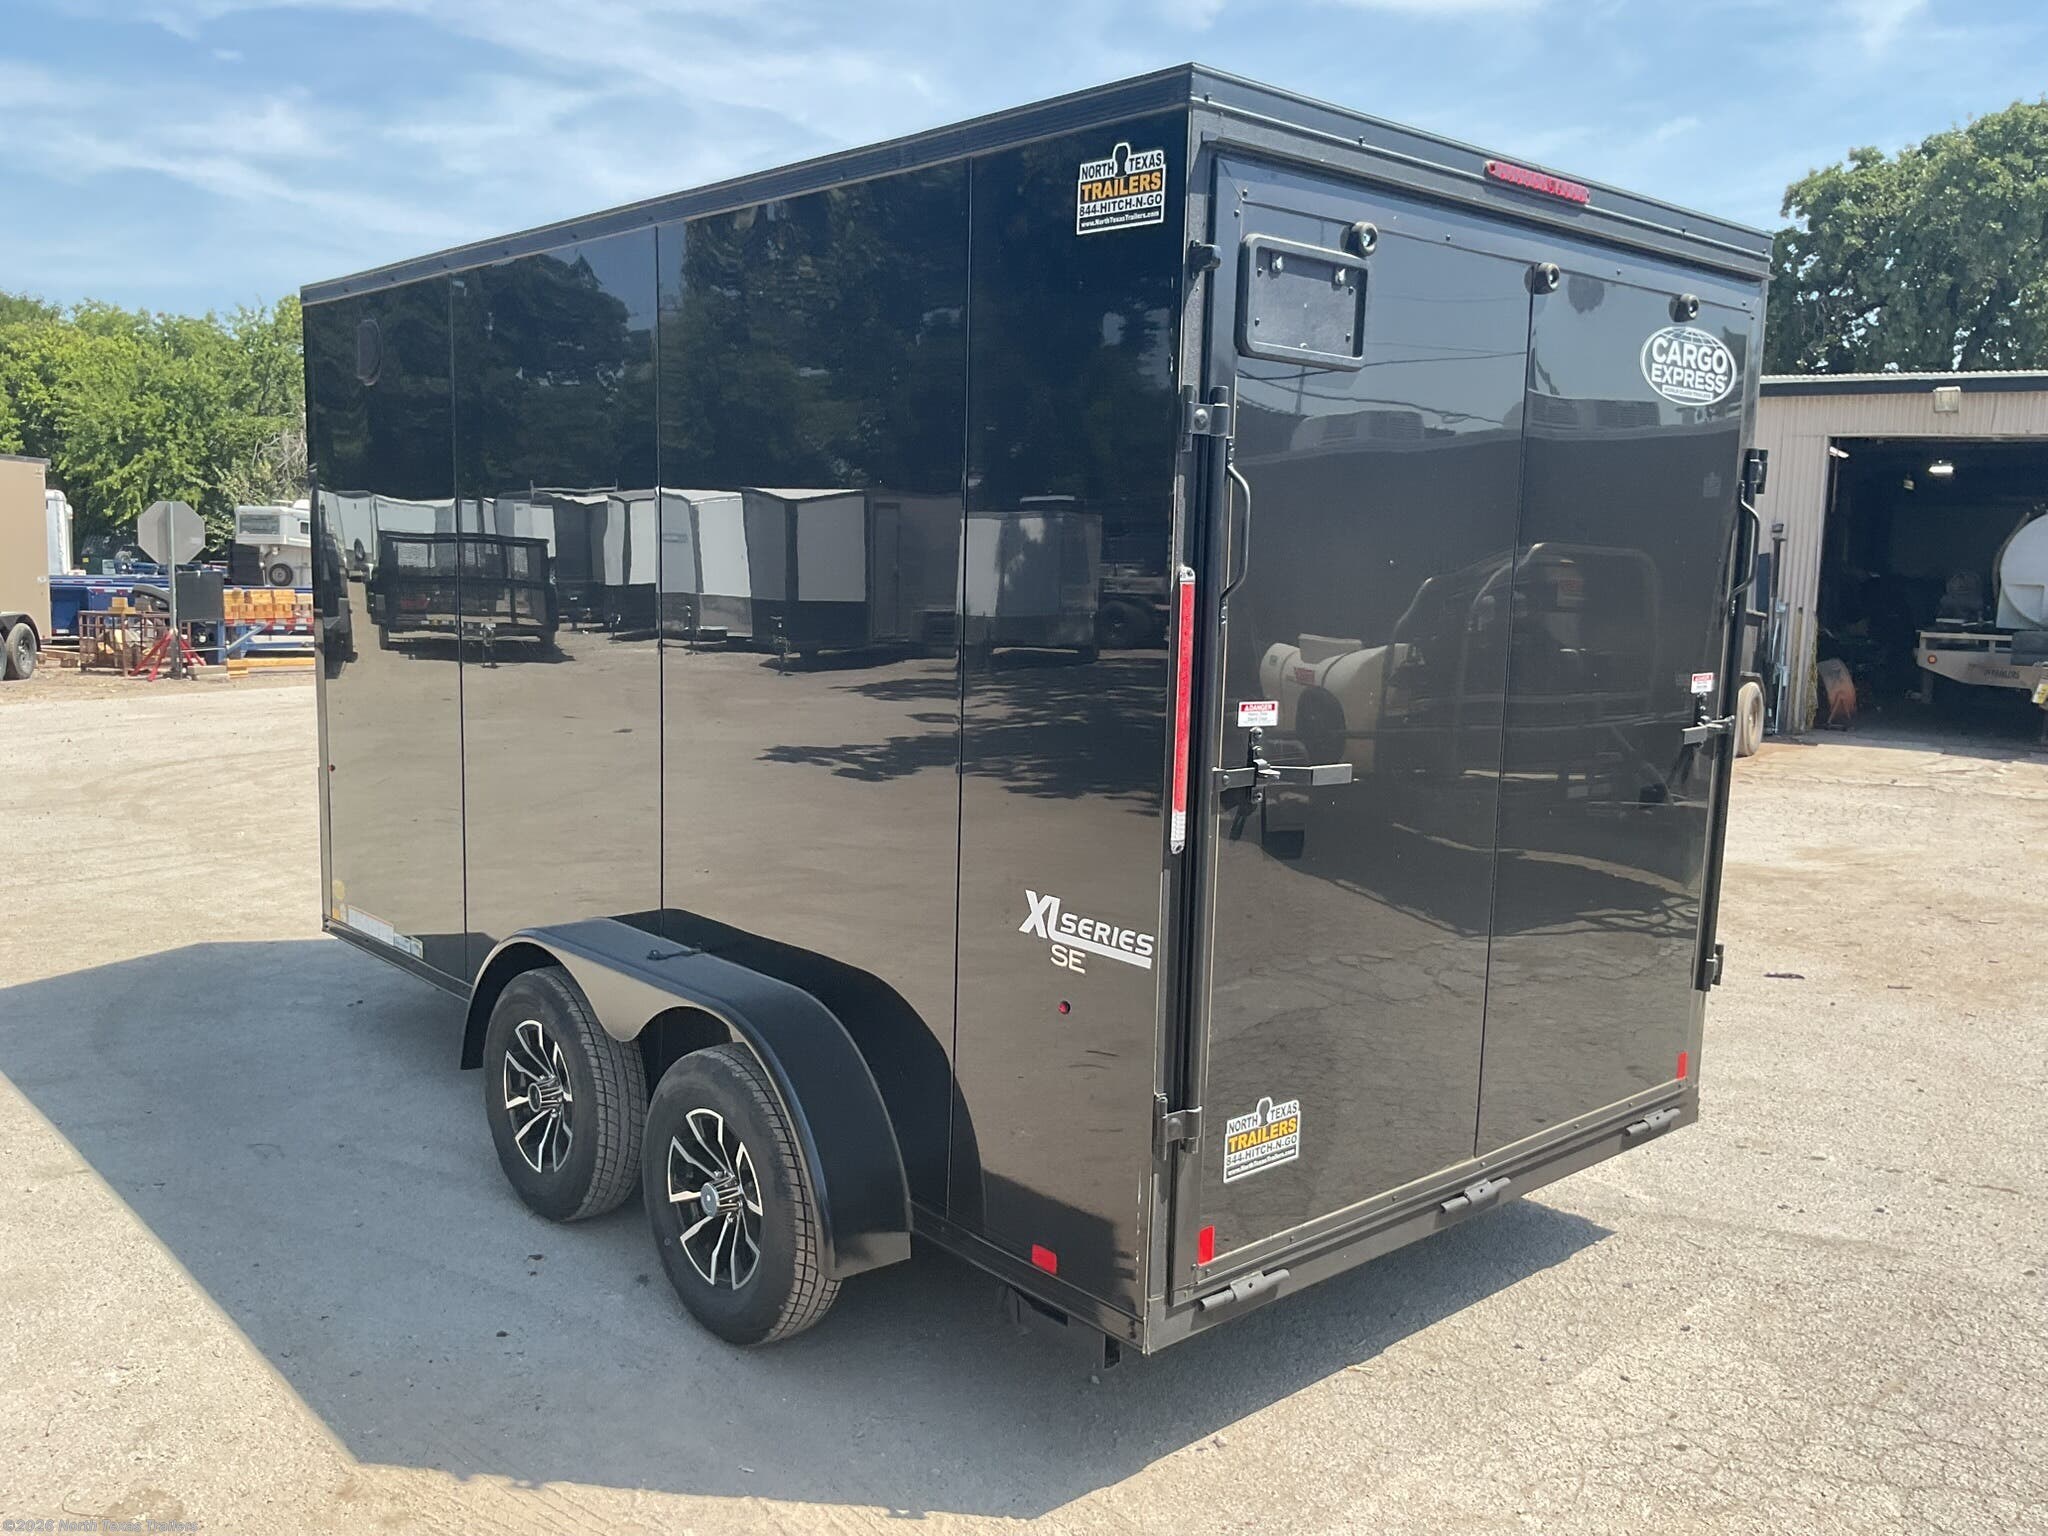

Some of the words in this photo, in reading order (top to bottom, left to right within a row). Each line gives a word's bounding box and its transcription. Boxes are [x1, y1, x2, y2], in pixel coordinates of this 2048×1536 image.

[1081, 161, 1115, 180] NORTH
[1128, 152, 1162, 172] TEXAS
[1081, 171, 1162, 202] TRAILERS
[1079, 193, 1163, 217] 844-HITCH-N-GO
[1651, 336, 1728, 374] CARGO
[1651, 362, 1728, 394] EXPRESS
[1050, 944, 1086, 974] SE
[1228, 1114, 1258, 1135] NORTH
[1270, 1102, 1298, 1121] TEXAS
[1228, 1117, 1297, 1153] TRAILERS
